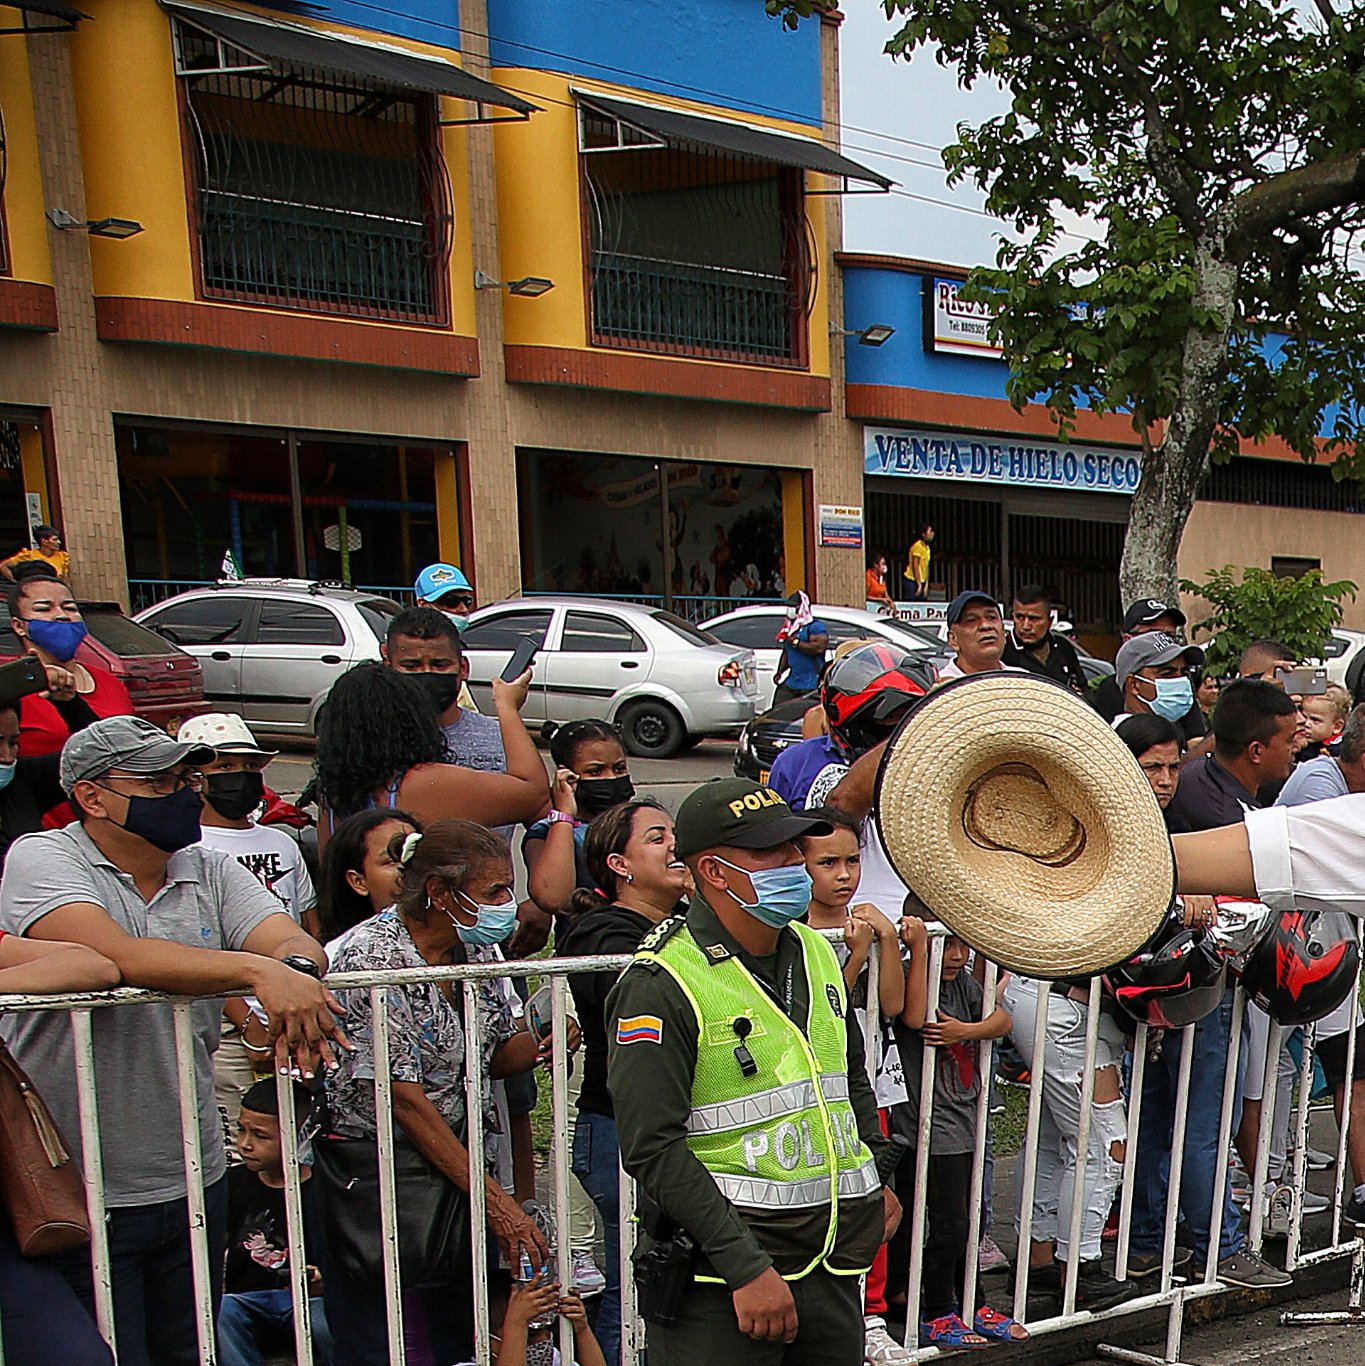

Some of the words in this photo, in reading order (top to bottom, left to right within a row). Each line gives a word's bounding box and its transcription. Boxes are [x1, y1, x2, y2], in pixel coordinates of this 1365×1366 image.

[874, 434, 965, 476] VENTA
[970, 442, 1003, 478] DE
[1008, 446, 1079, 485] HIELO
[1083, 453, 1140, 489] SECO
[877, 606, 921, 620] Crema
